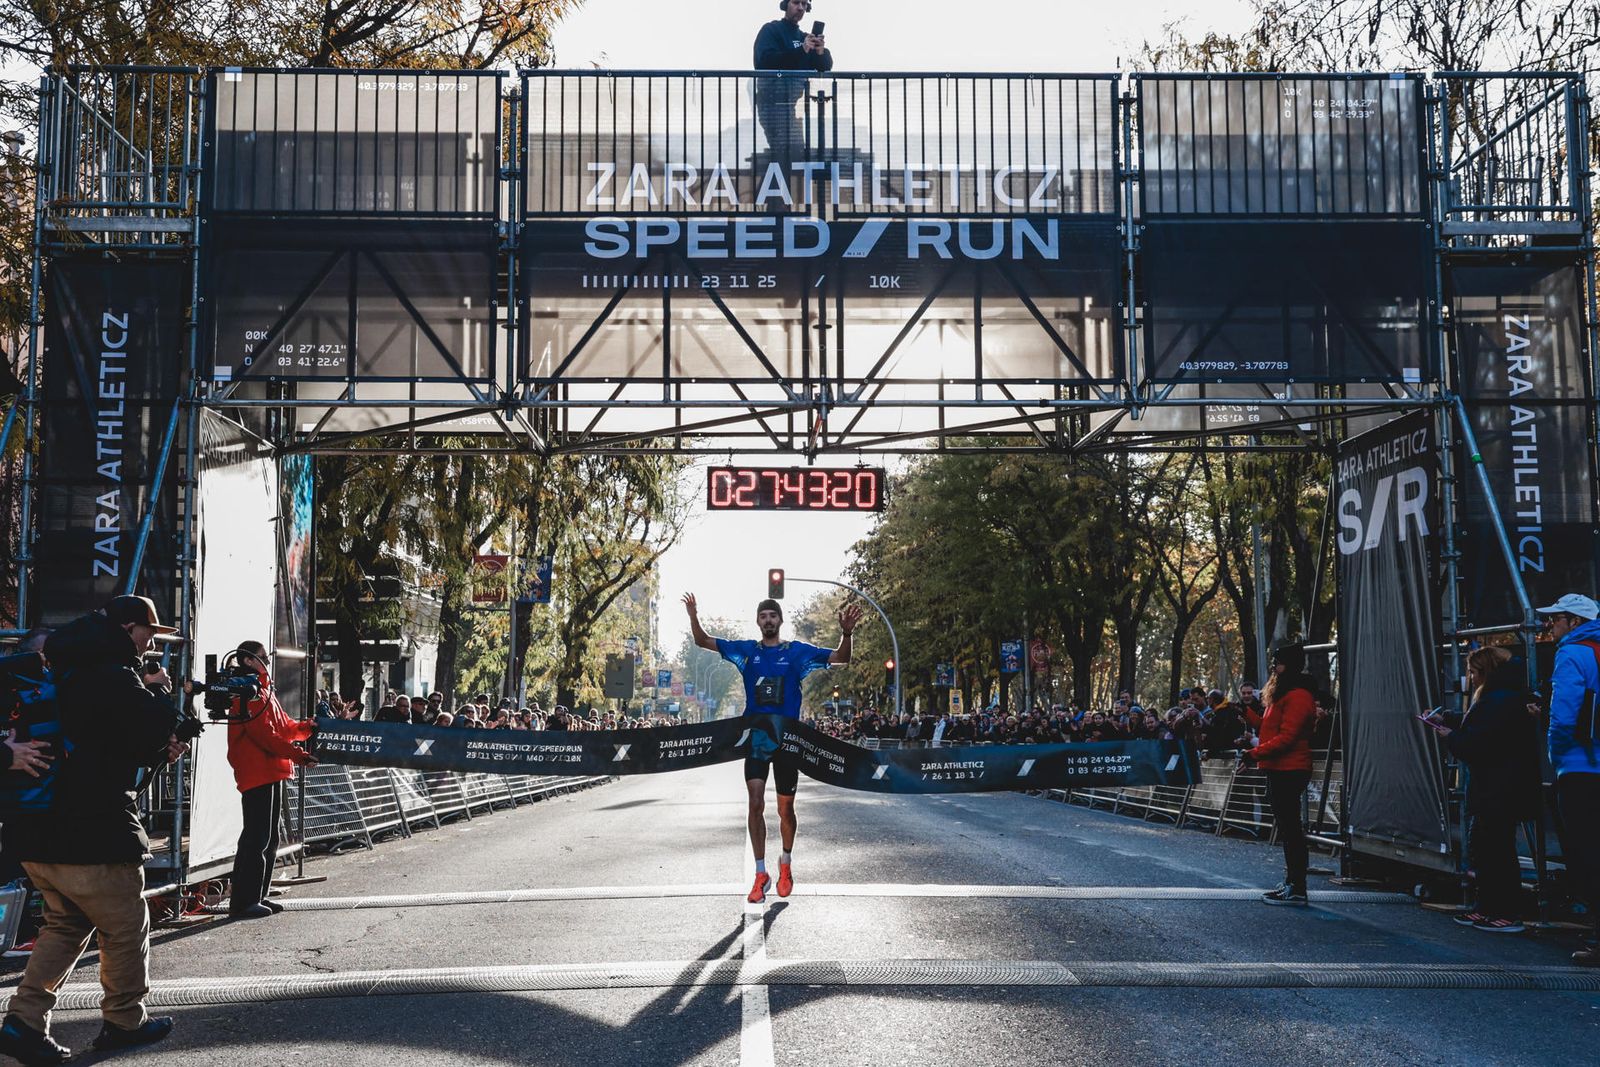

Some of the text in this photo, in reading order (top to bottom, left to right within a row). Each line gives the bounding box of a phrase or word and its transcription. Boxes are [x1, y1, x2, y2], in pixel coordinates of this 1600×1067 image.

[1284, 87, 1301, 96] 10K
[1284, 99, 1292, 107] N
[1313, 100, 1325, 108] 40
[586, 162, 1058, 207] ZARA ATHLETICZ
[584, 216, 831, 259] SPEED
[907, 218, 1059, 260] RUN
[701, 275, 720, 288] 23
[729, 275, 749, 288] 11
[757, 275, 776, 288] 25
[869, 275, 900, 288] 10K
[245, 331, 268, 340] 00K
[244, 344, 253, 353] N
[279, 345, 294, 353] 40
[300, 345, 316, 354] 27'
[278, 358, 292, 366] 03
[1180, 361, 1289, 370] 40.3979829, -3.707783
[93, 312, 129, 577] ZARA ATHLETICZ
[1503, 314, 1545, 572] ZARA ATHLETICZ
[1337, 427, 1428, 483] ZARA ATHLETICZ
[766, 686, 772, 694] 2
[317, 732, 340, 741] ZARA
[467, 741, 489, 750] ZARA
[660, 736, 713, 749] ZARA ATHLETICZ
[921, 761, 985, 771] ZARA ATHLETICZ
[1078, 766, 1089, 774] 03
